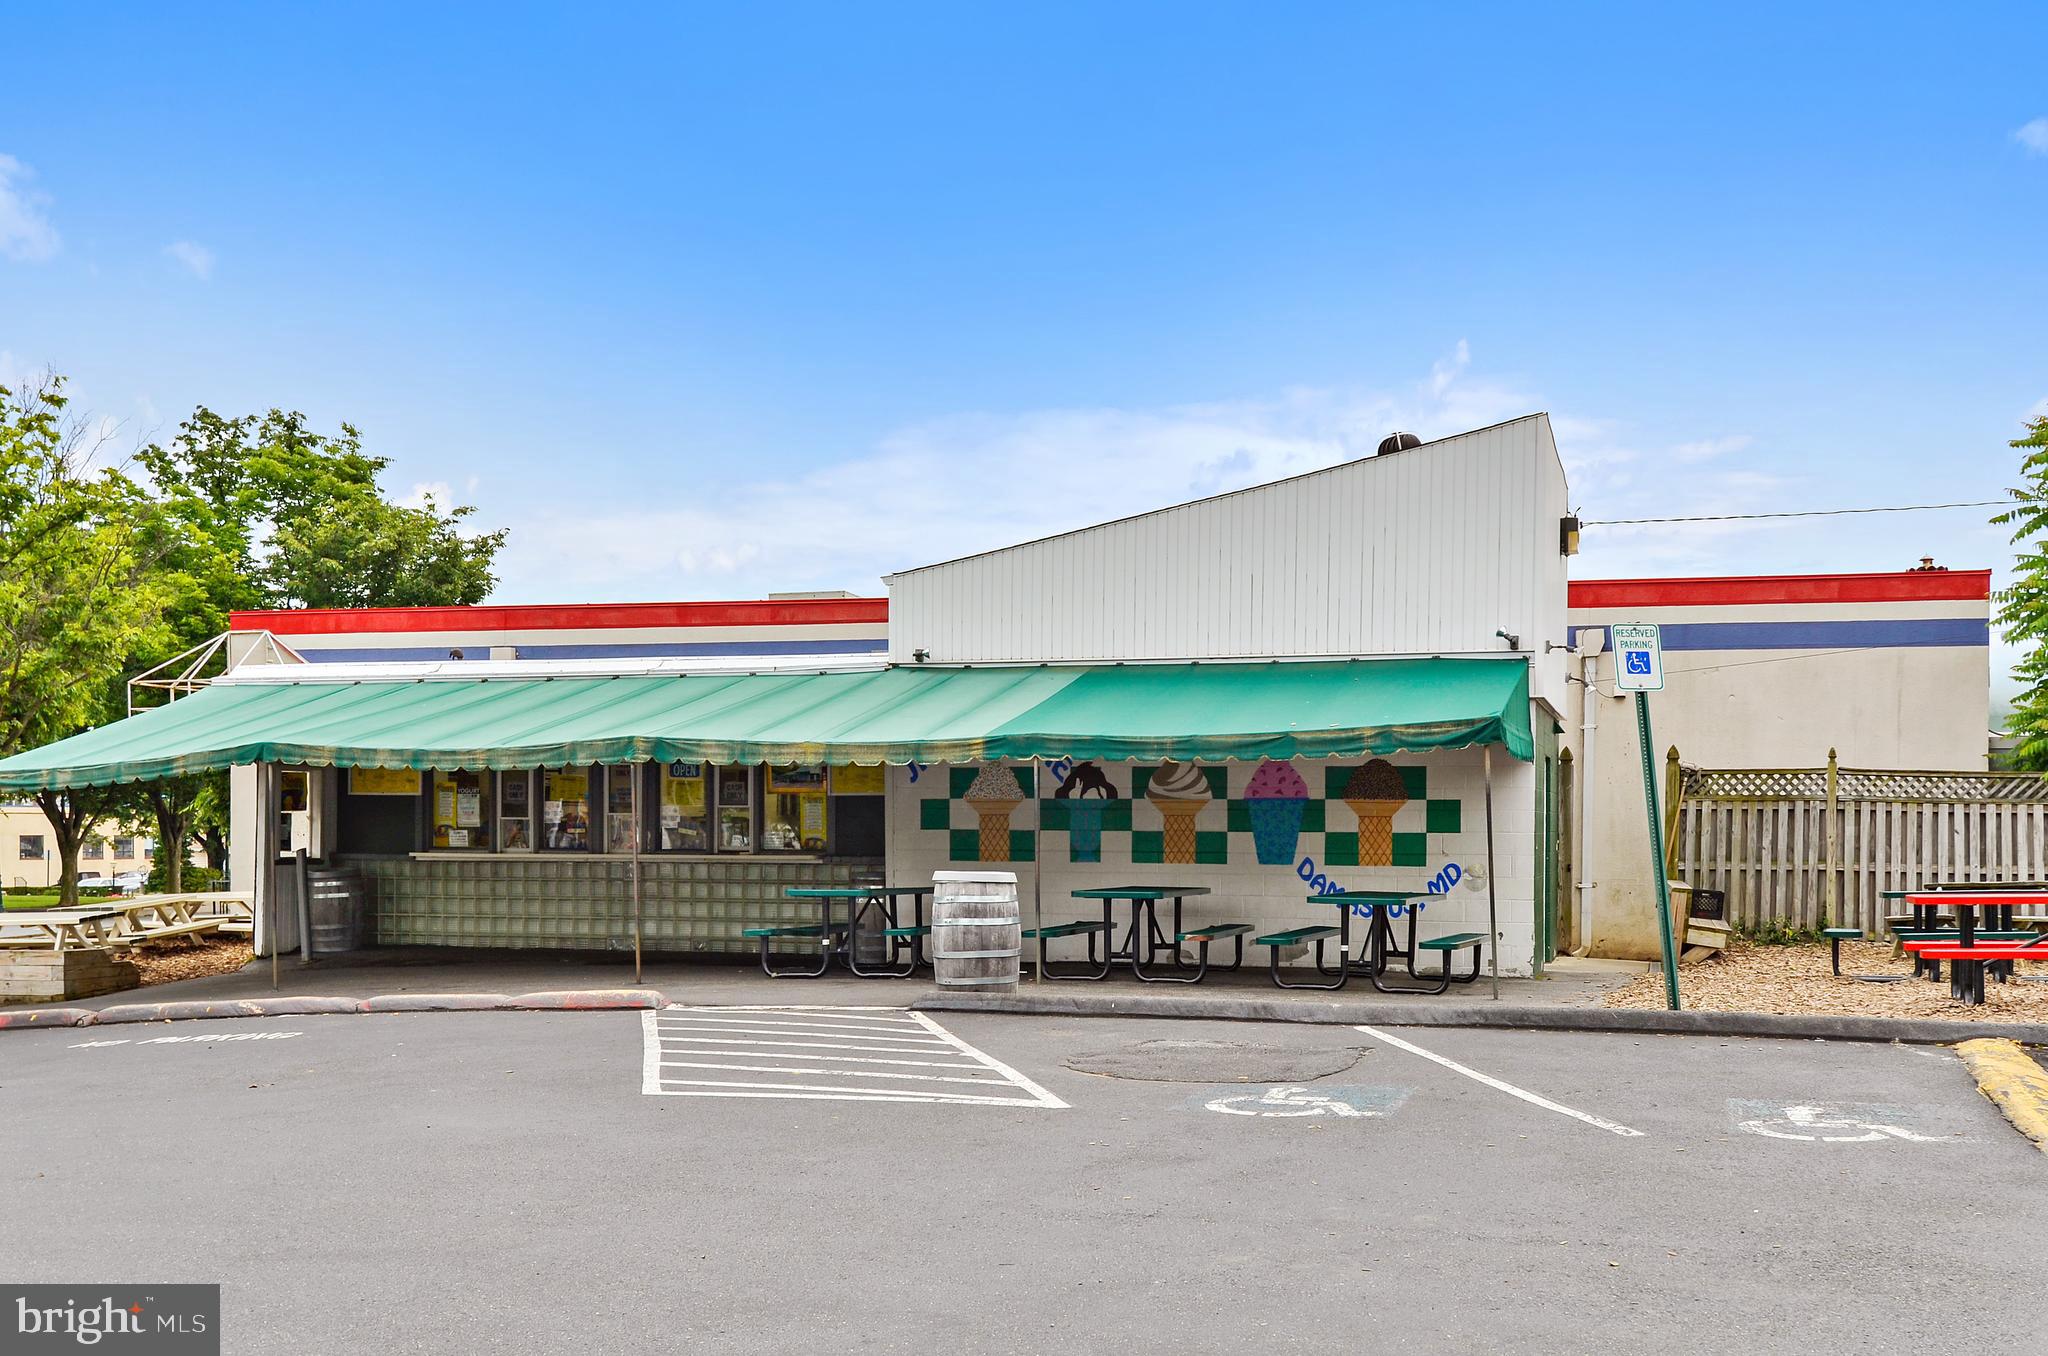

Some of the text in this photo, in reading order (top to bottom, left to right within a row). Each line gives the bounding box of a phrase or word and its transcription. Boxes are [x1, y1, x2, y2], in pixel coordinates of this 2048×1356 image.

[1616, 629, 1655, 637] RESERVED
[1620, 641, 1653, 649] PARKING
[673, 764, 697, 776] OPEN
[1427, 863, 1462, 894] MD
